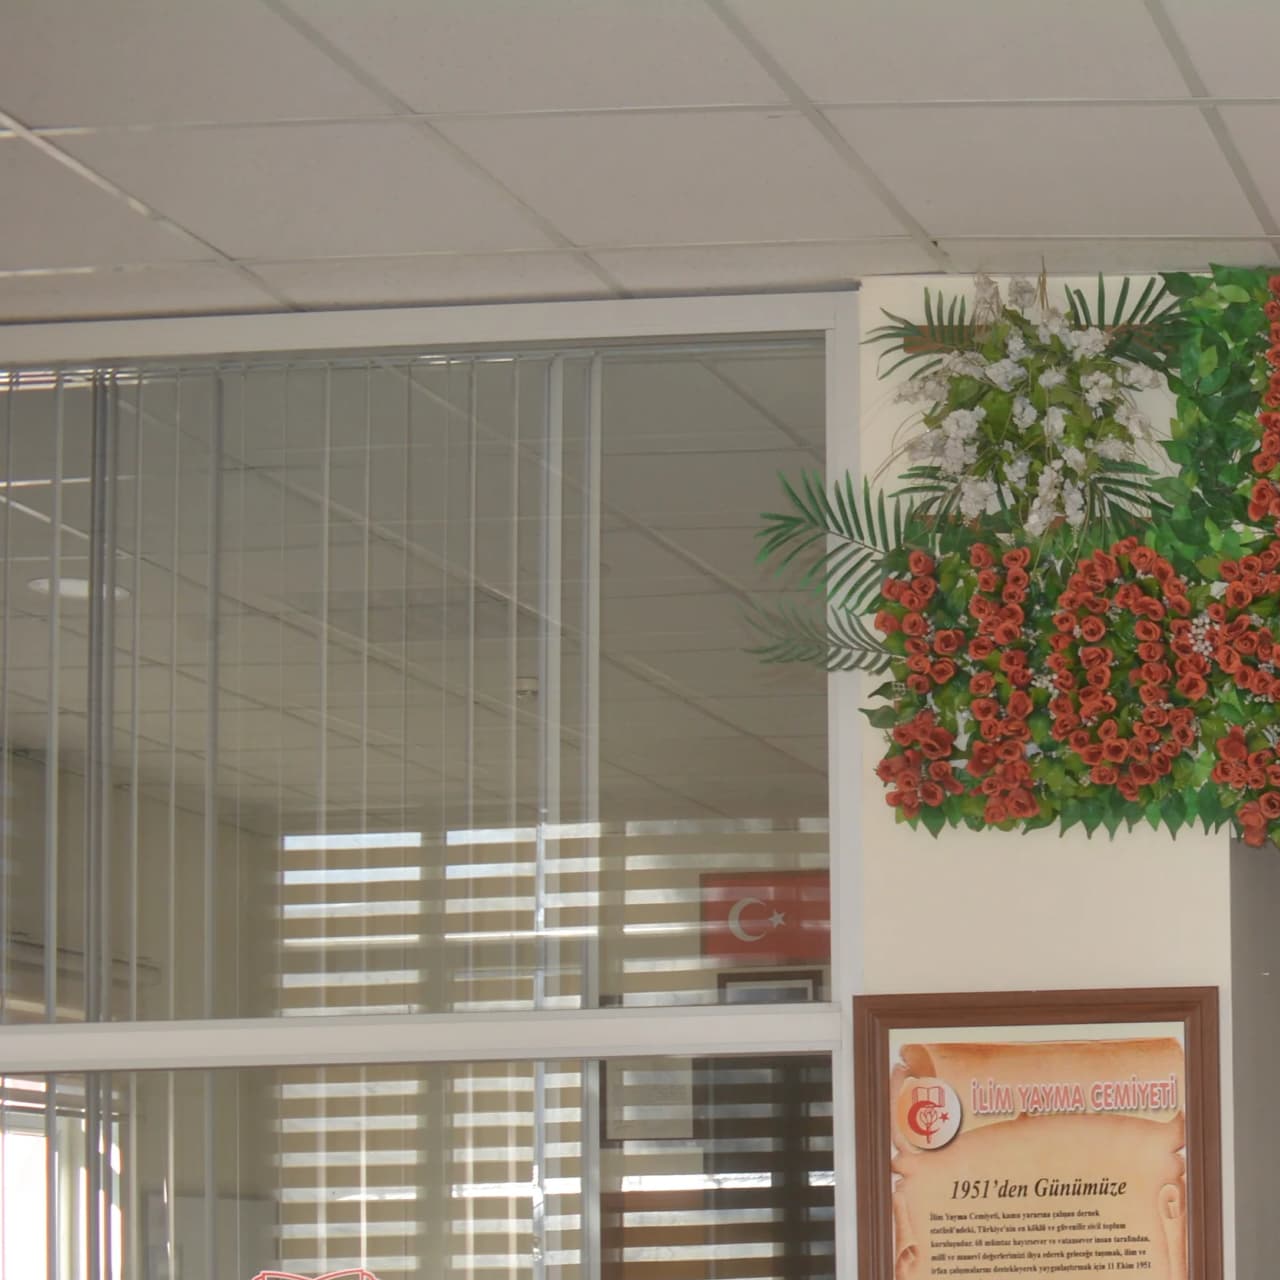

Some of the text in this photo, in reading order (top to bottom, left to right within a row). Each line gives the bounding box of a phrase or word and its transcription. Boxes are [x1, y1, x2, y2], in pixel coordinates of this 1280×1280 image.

[971, 1073, 1178, 1115] İLİM YAYMA CEMİYETİ
[1034, 1177, 1127, 1198] Günümüze
